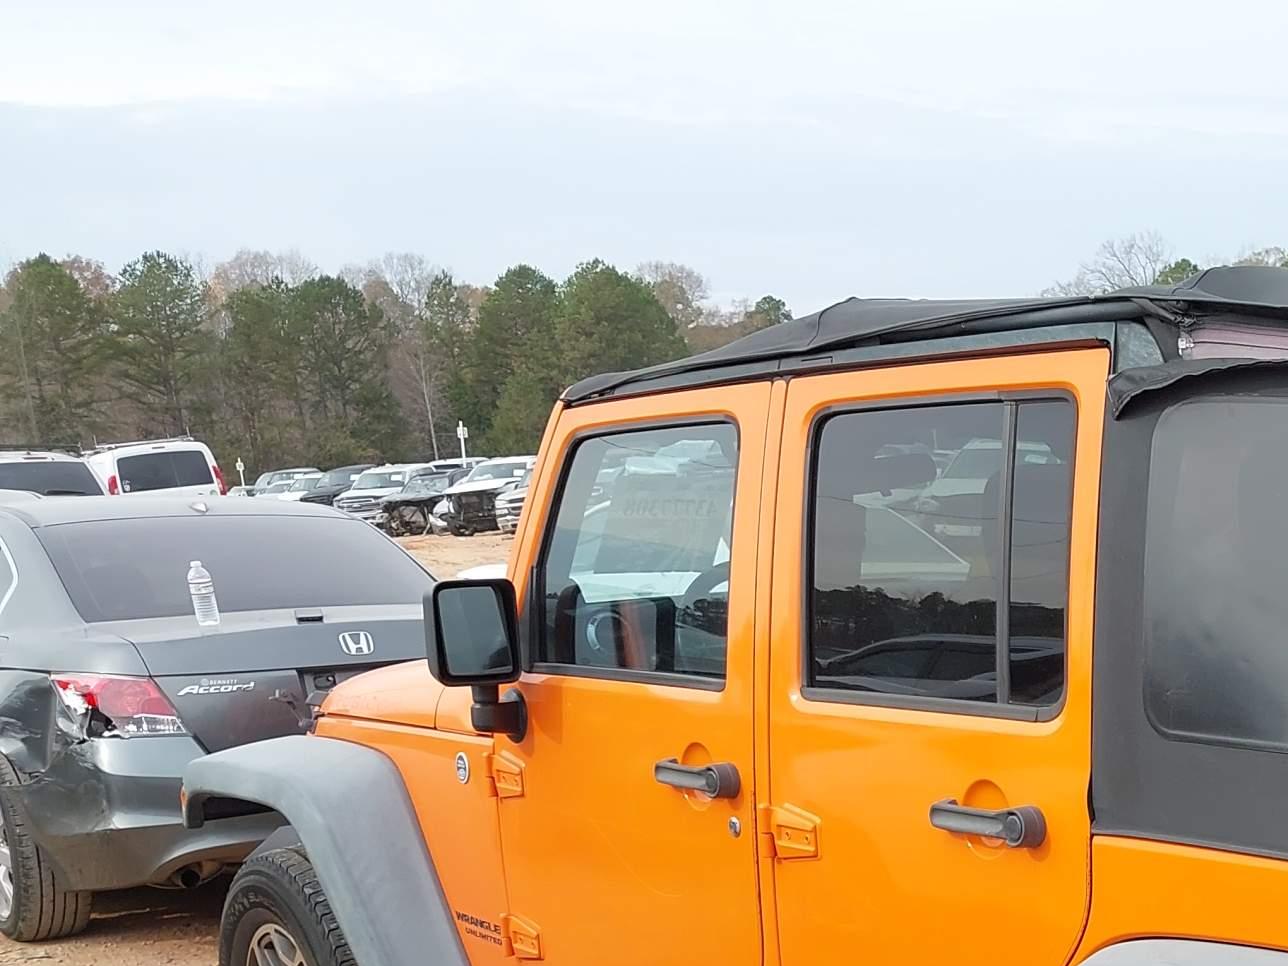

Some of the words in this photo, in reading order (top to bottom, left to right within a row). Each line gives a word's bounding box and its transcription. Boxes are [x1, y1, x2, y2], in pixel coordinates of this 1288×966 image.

[177, 681, 255, 696] Accord
[455, 911, 502, 935] WRANGLE
[465, 927, 503, 946] UNLIMITED
